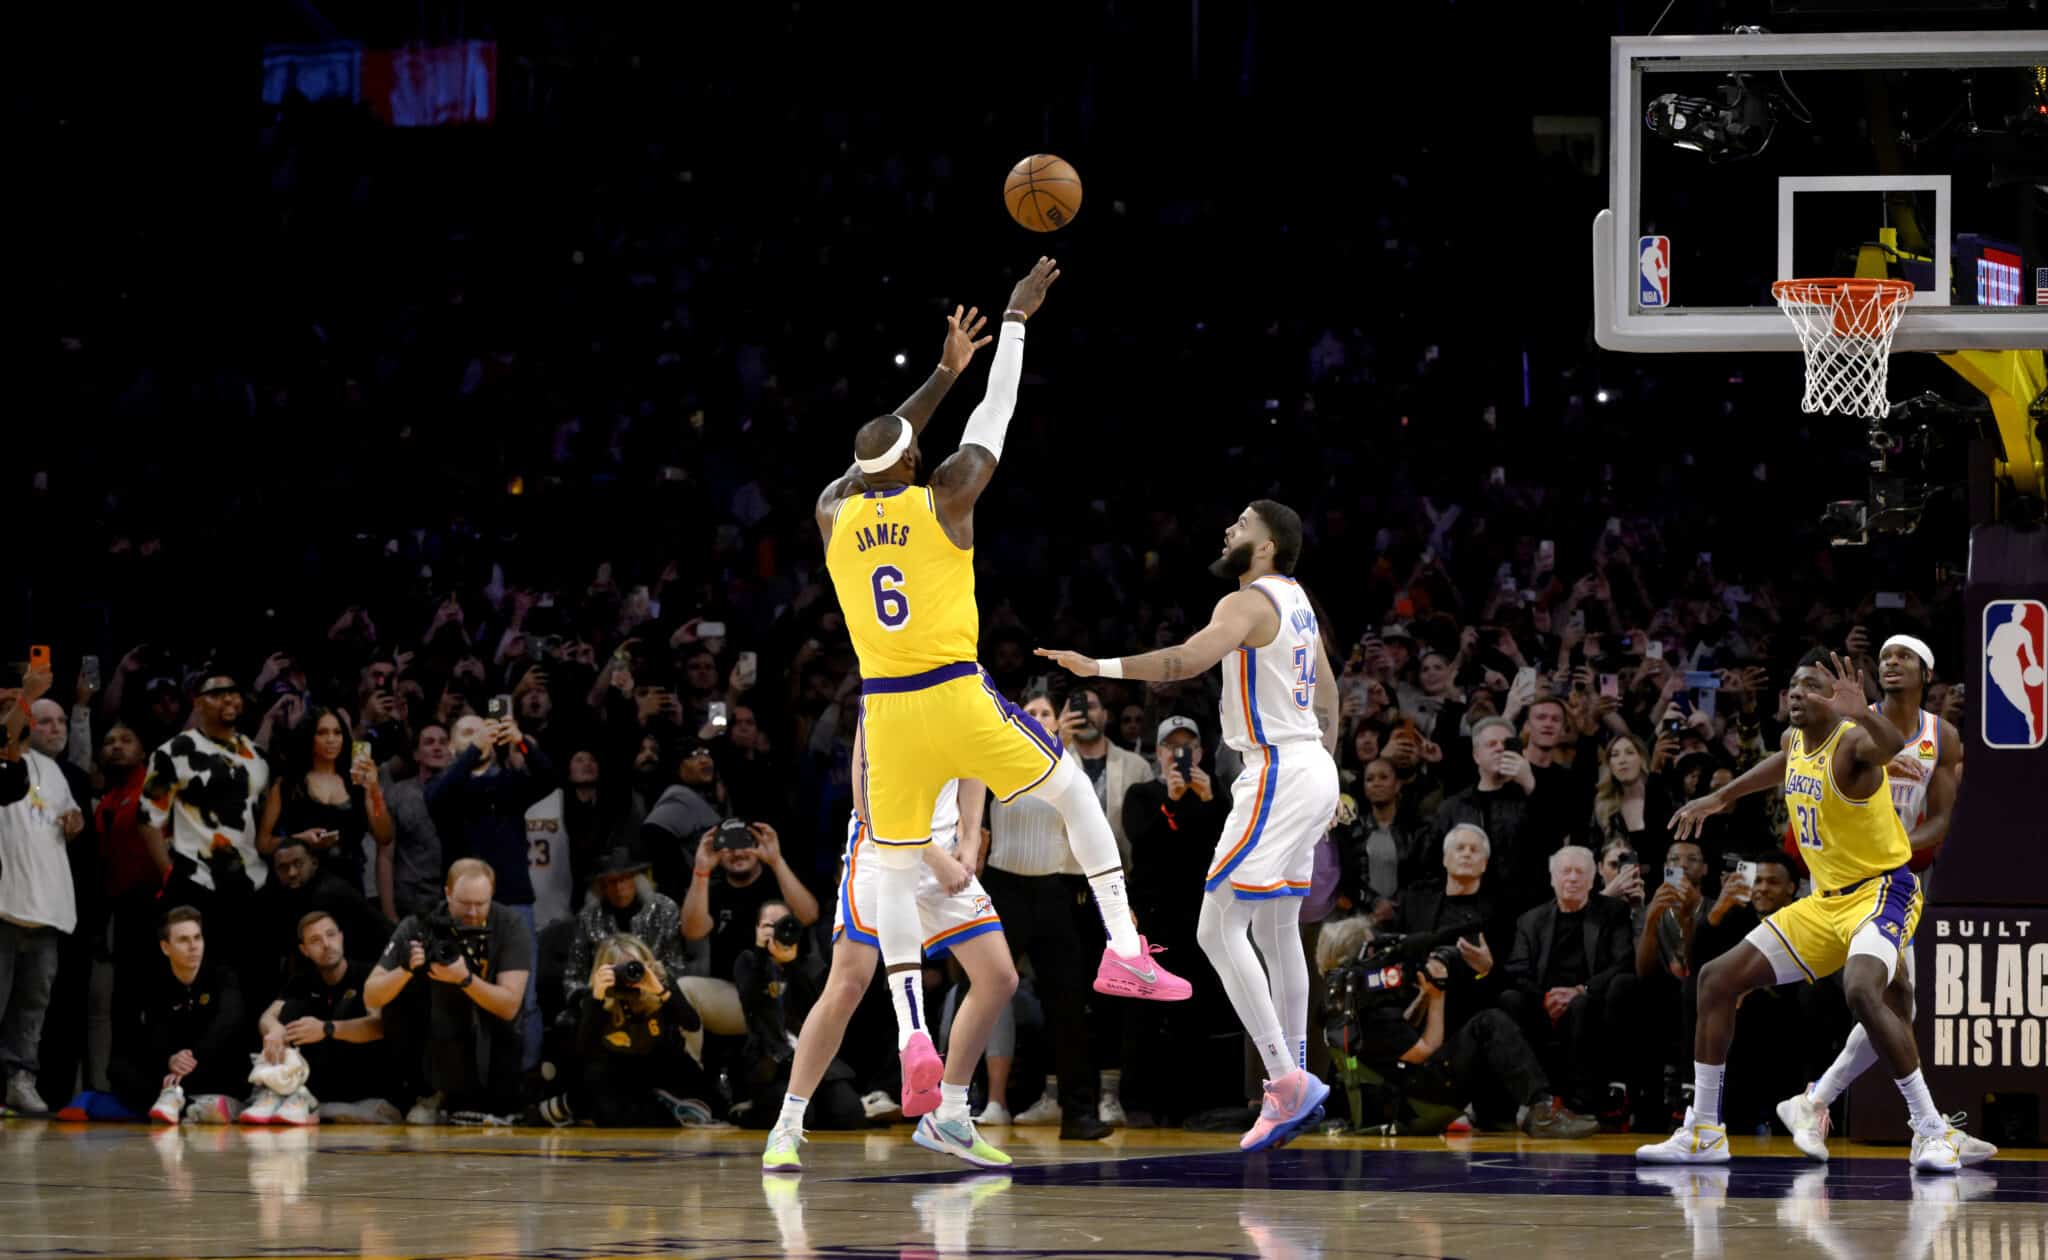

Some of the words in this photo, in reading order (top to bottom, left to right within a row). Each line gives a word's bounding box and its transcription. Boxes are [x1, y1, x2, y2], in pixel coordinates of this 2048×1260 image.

[1643, 291, 1658, 302] NBA
[856, 523, 910, 552] JAMES
[871, 564, 910, 632] 6
[1797, 804, 1823, 849] 31
[528, 839, 550, 866] 3
[1936, 920, 2031, 937] BUILT
[1935, 943, 2048, 1017] BLAC
[1934, 1018, 2048, 1067] HISTO
